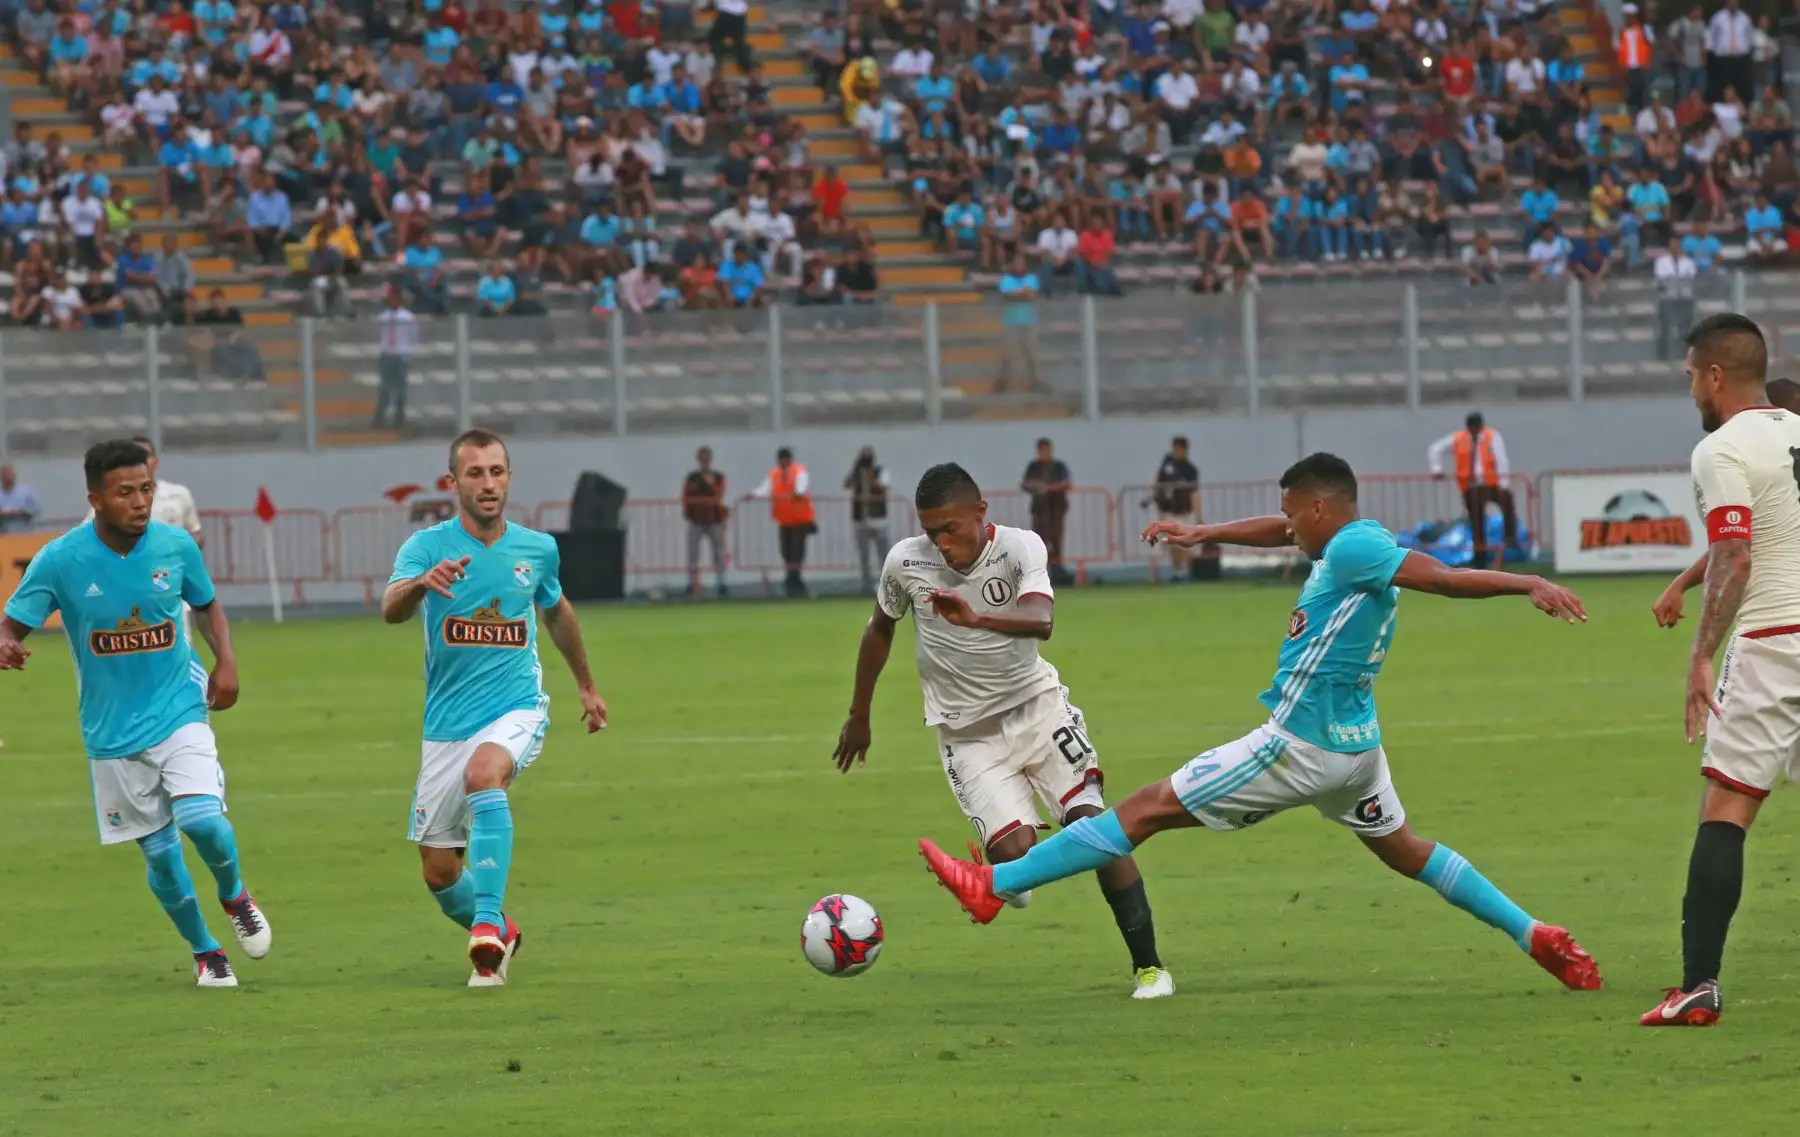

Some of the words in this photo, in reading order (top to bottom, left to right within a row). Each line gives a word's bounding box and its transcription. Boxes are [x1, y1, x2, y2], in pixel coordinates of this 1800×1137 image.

[987, 581, 1006, 603] U
[98, 628, 169, 650] CRISTAL
[452, 622, 523, 642] CRISTAL
[507, 723, 528, 741] 7
[1052, 725, 1093, 764] 20
